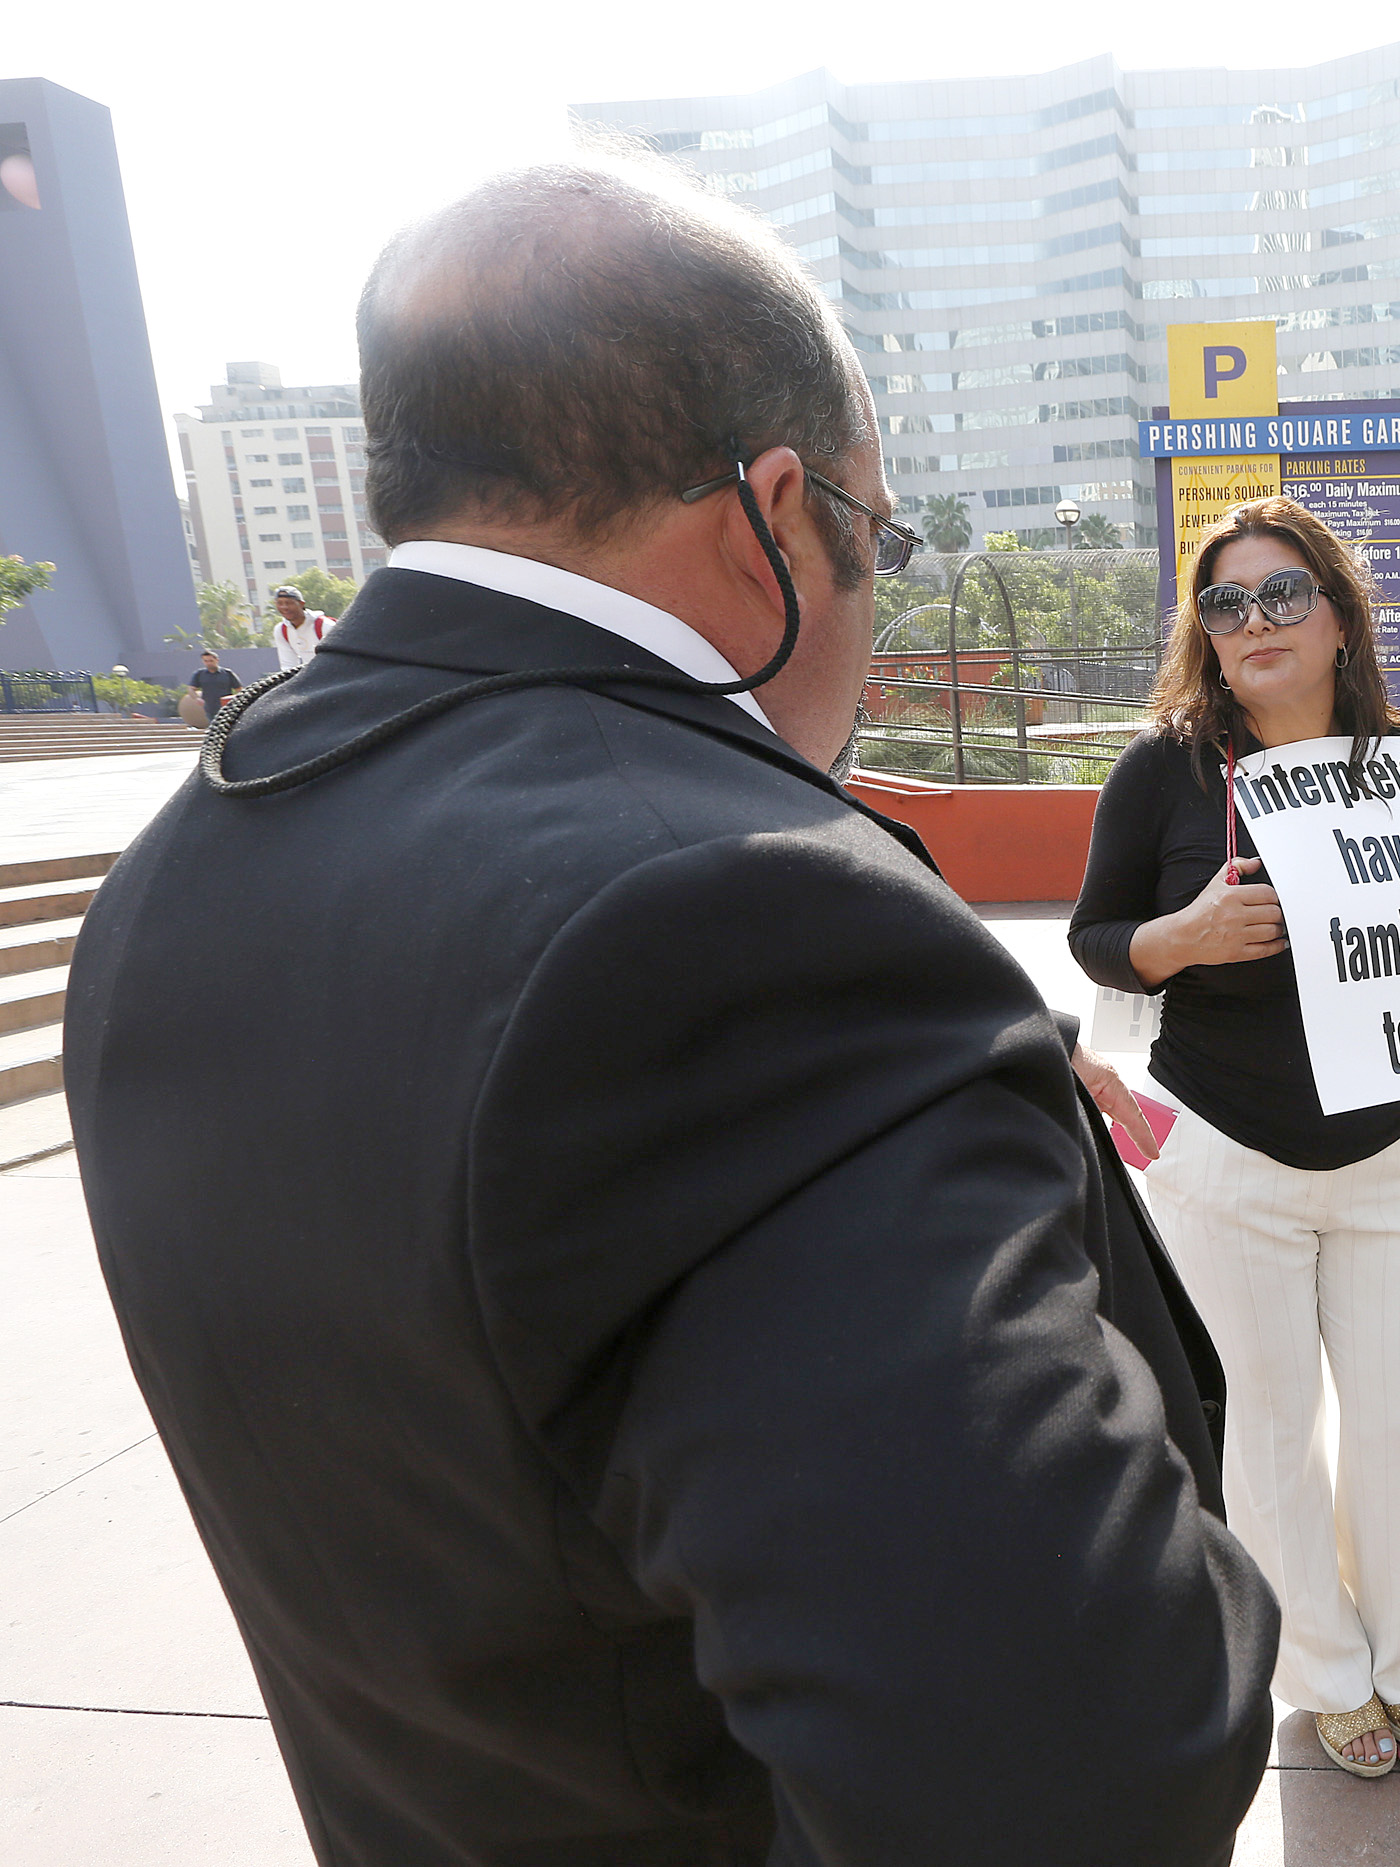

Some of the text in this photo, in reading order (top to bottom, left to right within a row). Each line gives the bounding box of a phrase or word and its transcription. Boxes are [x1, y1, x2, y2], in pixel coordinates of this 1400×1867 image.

[1202, 345, 1247, 399] P
[1149, 422, 1256, 451] PERSHING
[1268, 419, 1352, 451] SQUARE
[1178, 463, 1274, 476] CONVENIENT PARKING FOR
[1286, 458, 1366, 475] PARKING RATES
[1178, 484, 1275, 501] PERSHING SQUARE
[1325, 482, 1353, 500] Daily
[1338, 500, 1368, 508] minutes
[1327, 520, 1345, 528] Pays
[1346, 519, 1381, 527] Maximum
